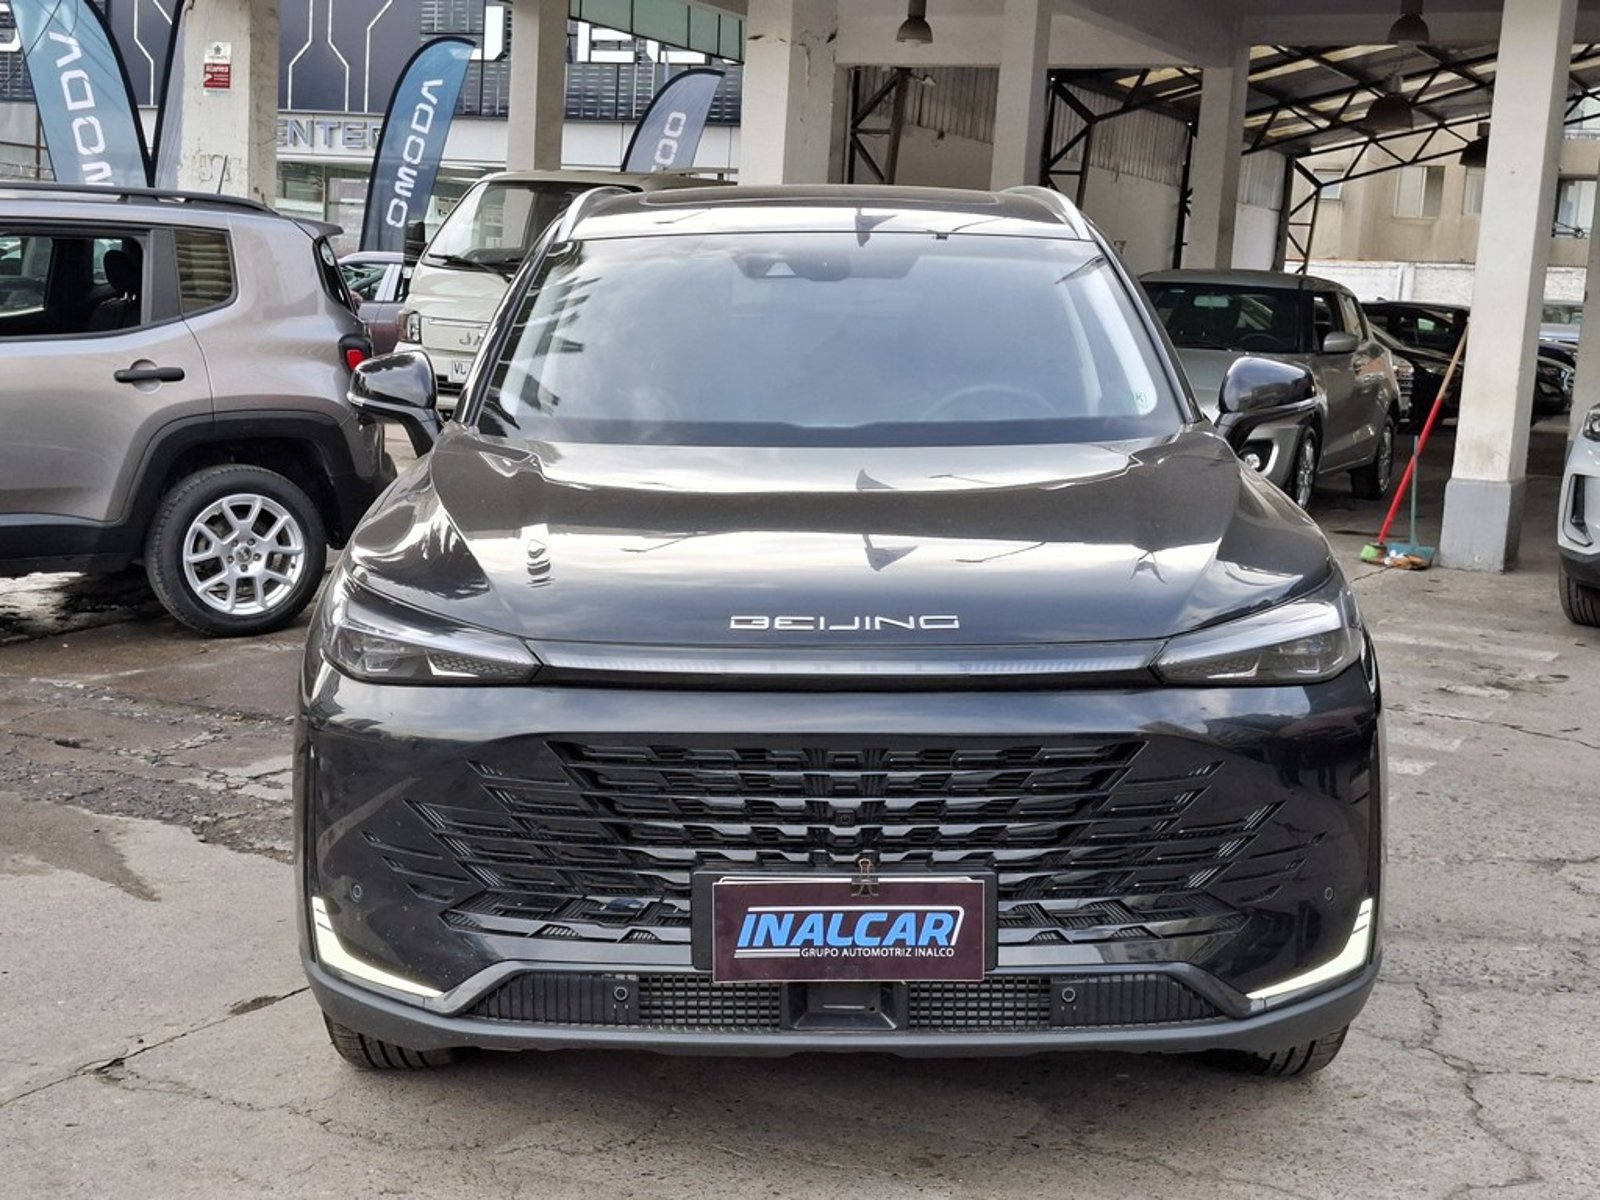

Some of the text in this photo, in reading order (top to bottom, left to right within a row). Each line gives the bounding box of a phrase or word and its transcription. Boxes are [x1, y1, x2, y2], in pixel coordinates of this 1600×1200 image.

[729, 615, 960, 631] BEIJING
[737, 912, 955, 948] INALCAR
[801, 947, 955, 957] GRUPO AUTOMOTRIZ INALCO
